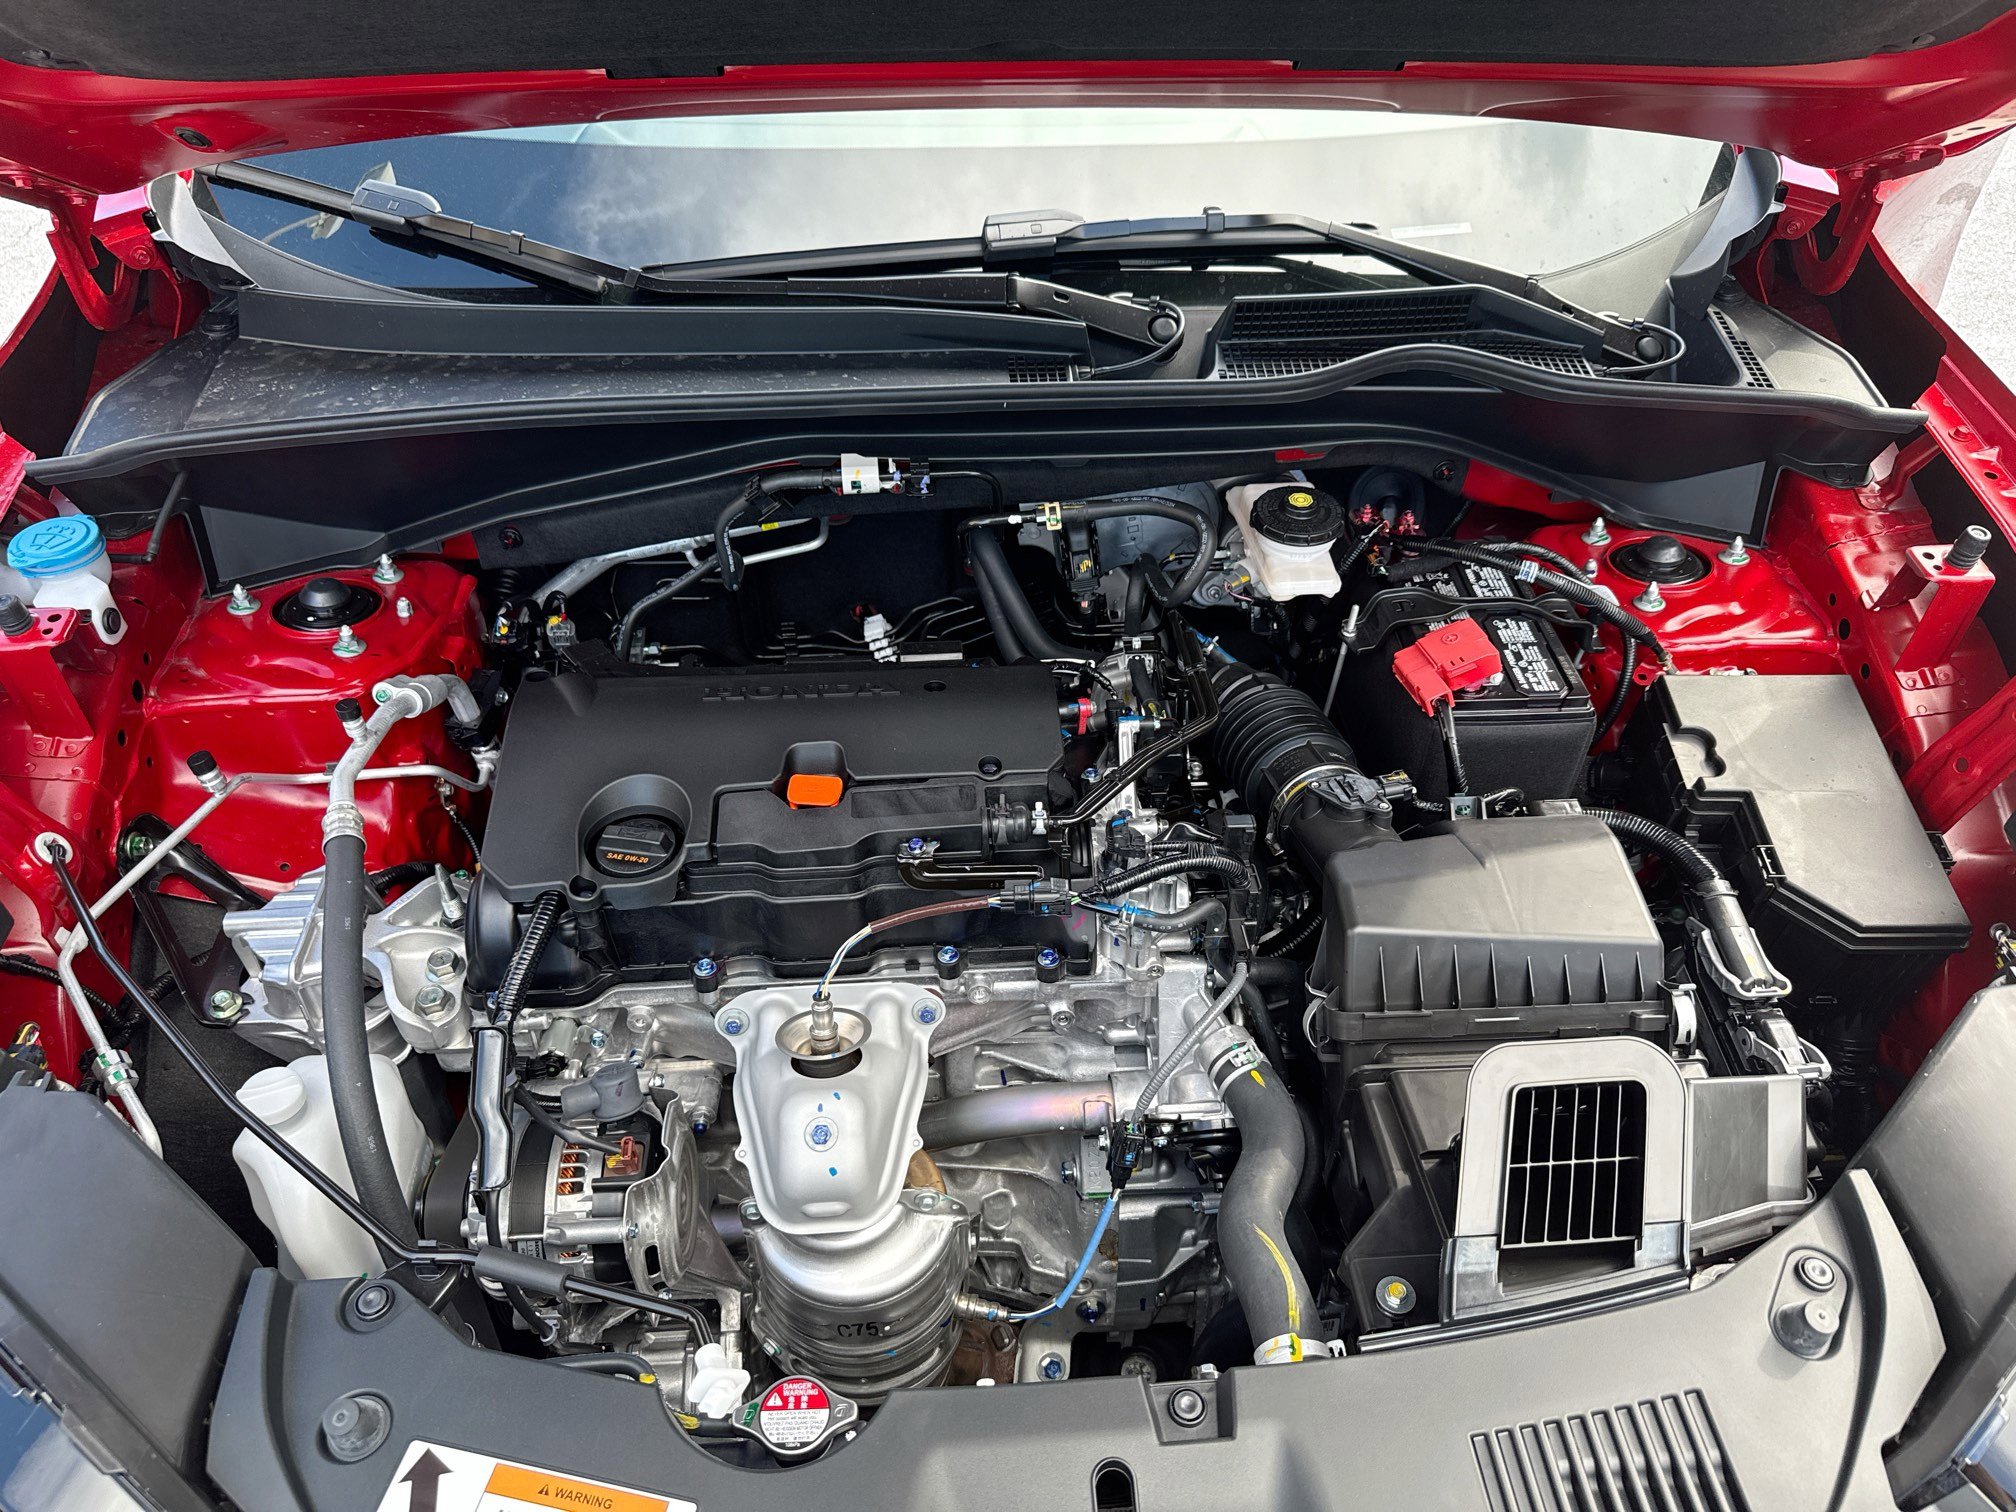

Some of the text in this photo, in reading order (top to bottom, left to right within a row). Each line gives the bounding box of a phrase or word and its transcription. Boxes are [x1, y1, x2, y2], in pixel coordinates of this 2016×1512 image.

[702, 682, 900, 701] HONDA
[606, 852, 649, 864] SAE 0W-20
[554, 1487, 614, 1510] WARNING
